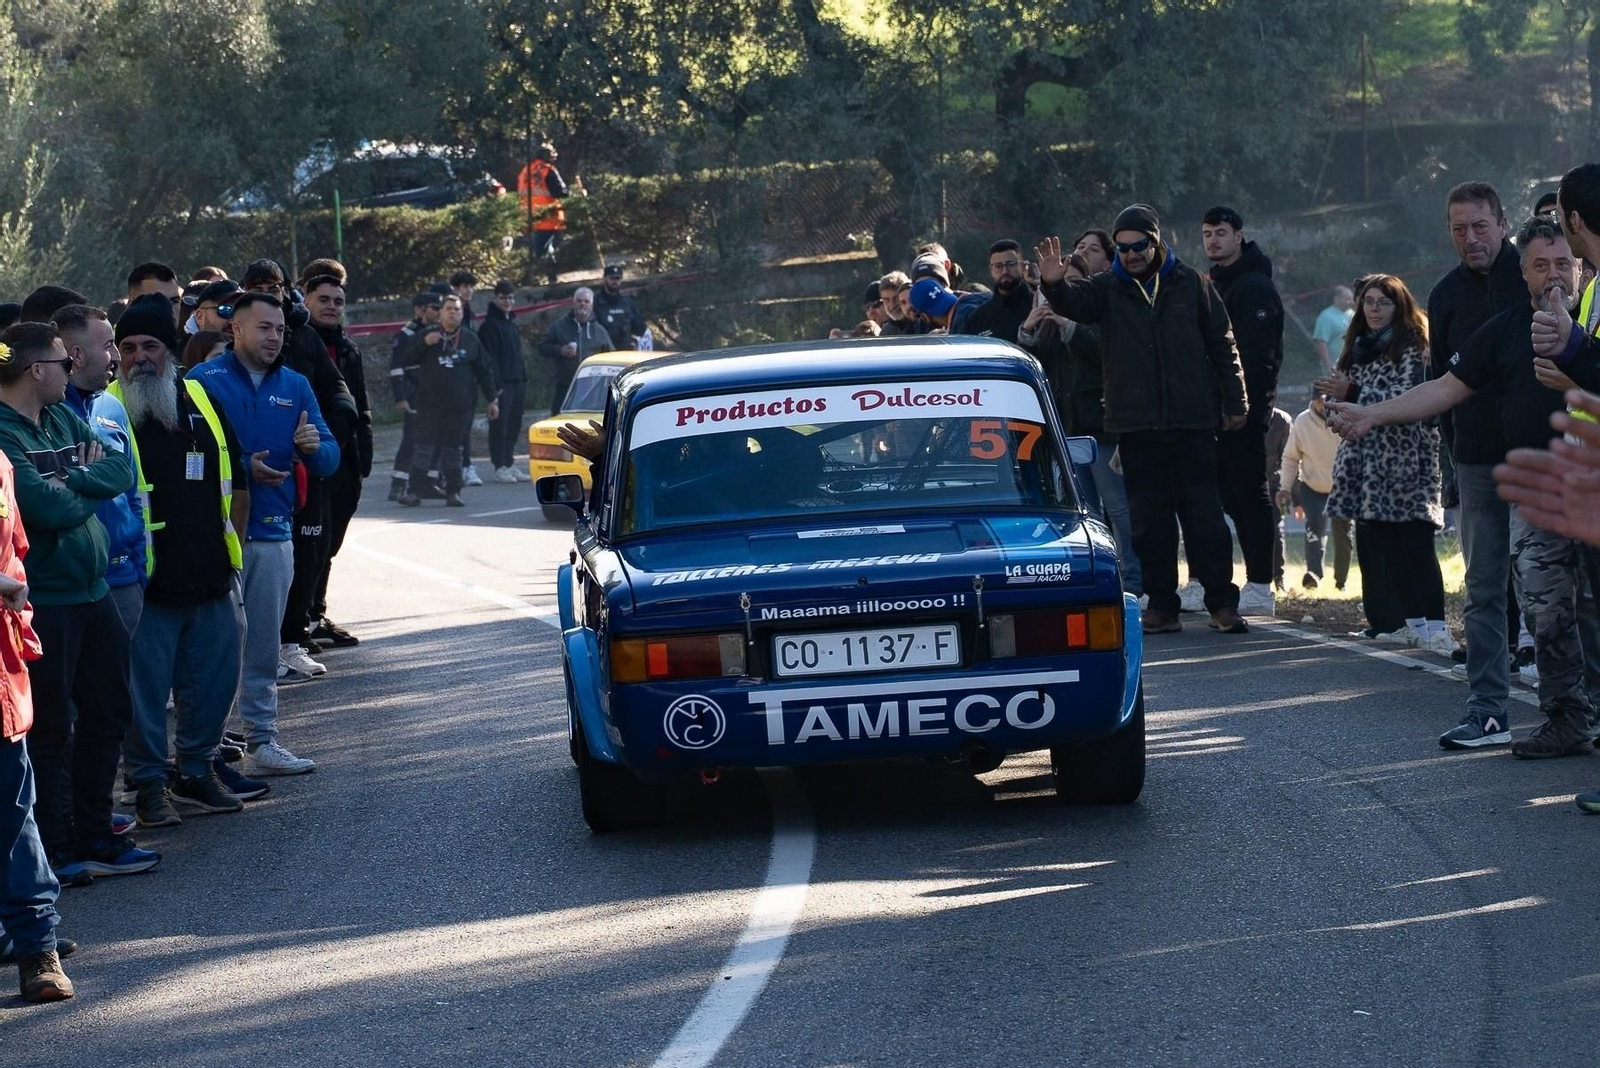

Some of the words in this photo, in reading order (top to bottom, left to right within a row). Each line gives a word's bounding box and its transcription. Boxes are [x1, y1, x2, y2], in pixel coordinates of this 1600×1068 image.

[676, 397, 827, 427] Productos
[851, 387, 984, 411] Dulcesol
[969, 421, 1042, 461] 57
[651, 562, 793, 586] TALLERES
[1005, 565, 1023, 577] LA
[1027, 562, 1071, 576] GUAPA
[1037, 573, 1070, 582] RACING
[761, 604, 850, 620] Maaama
[856, 598, 946, 613] iillooooo
[748, 669, 1080, 746] TAMECO
